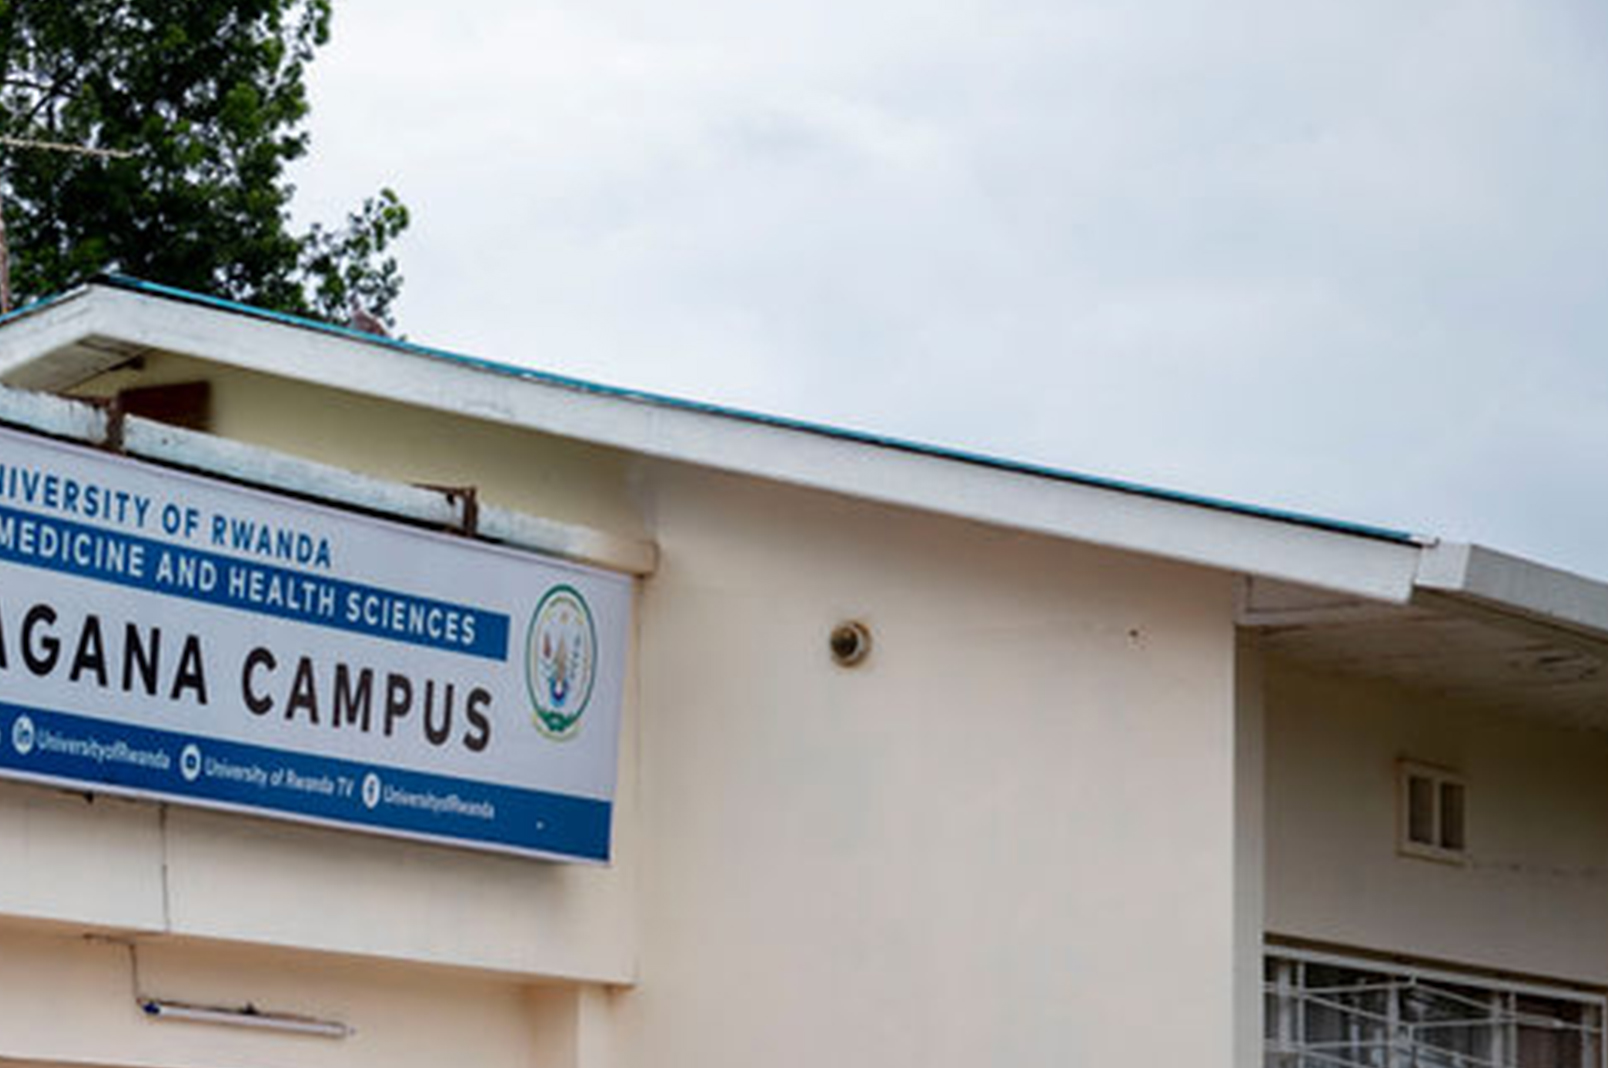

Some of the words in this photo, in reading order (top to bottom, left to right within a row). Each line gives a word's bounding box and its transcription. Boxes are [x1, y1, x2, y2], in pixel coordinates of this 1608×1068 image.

[161, 503, 200, 539] OF
[210, 514, 332, 568] RWANDA
[155, 552, 218, 592] AND
[229, 565, 335, 617] HEALTH
[344, 591, 476, 645] SCIENCES
[241, 646, 493, 753] CAMPUS
[37, 730, 172, 770] UniversityofRwanda
[204, 757, 267, 787] University
[270, 769, 283, 786] of
[286, 770, 335, 796] Rwanda
[337, 776, 355, 798] TV
[382, 785, 495, 819] UniversityofRwanda
